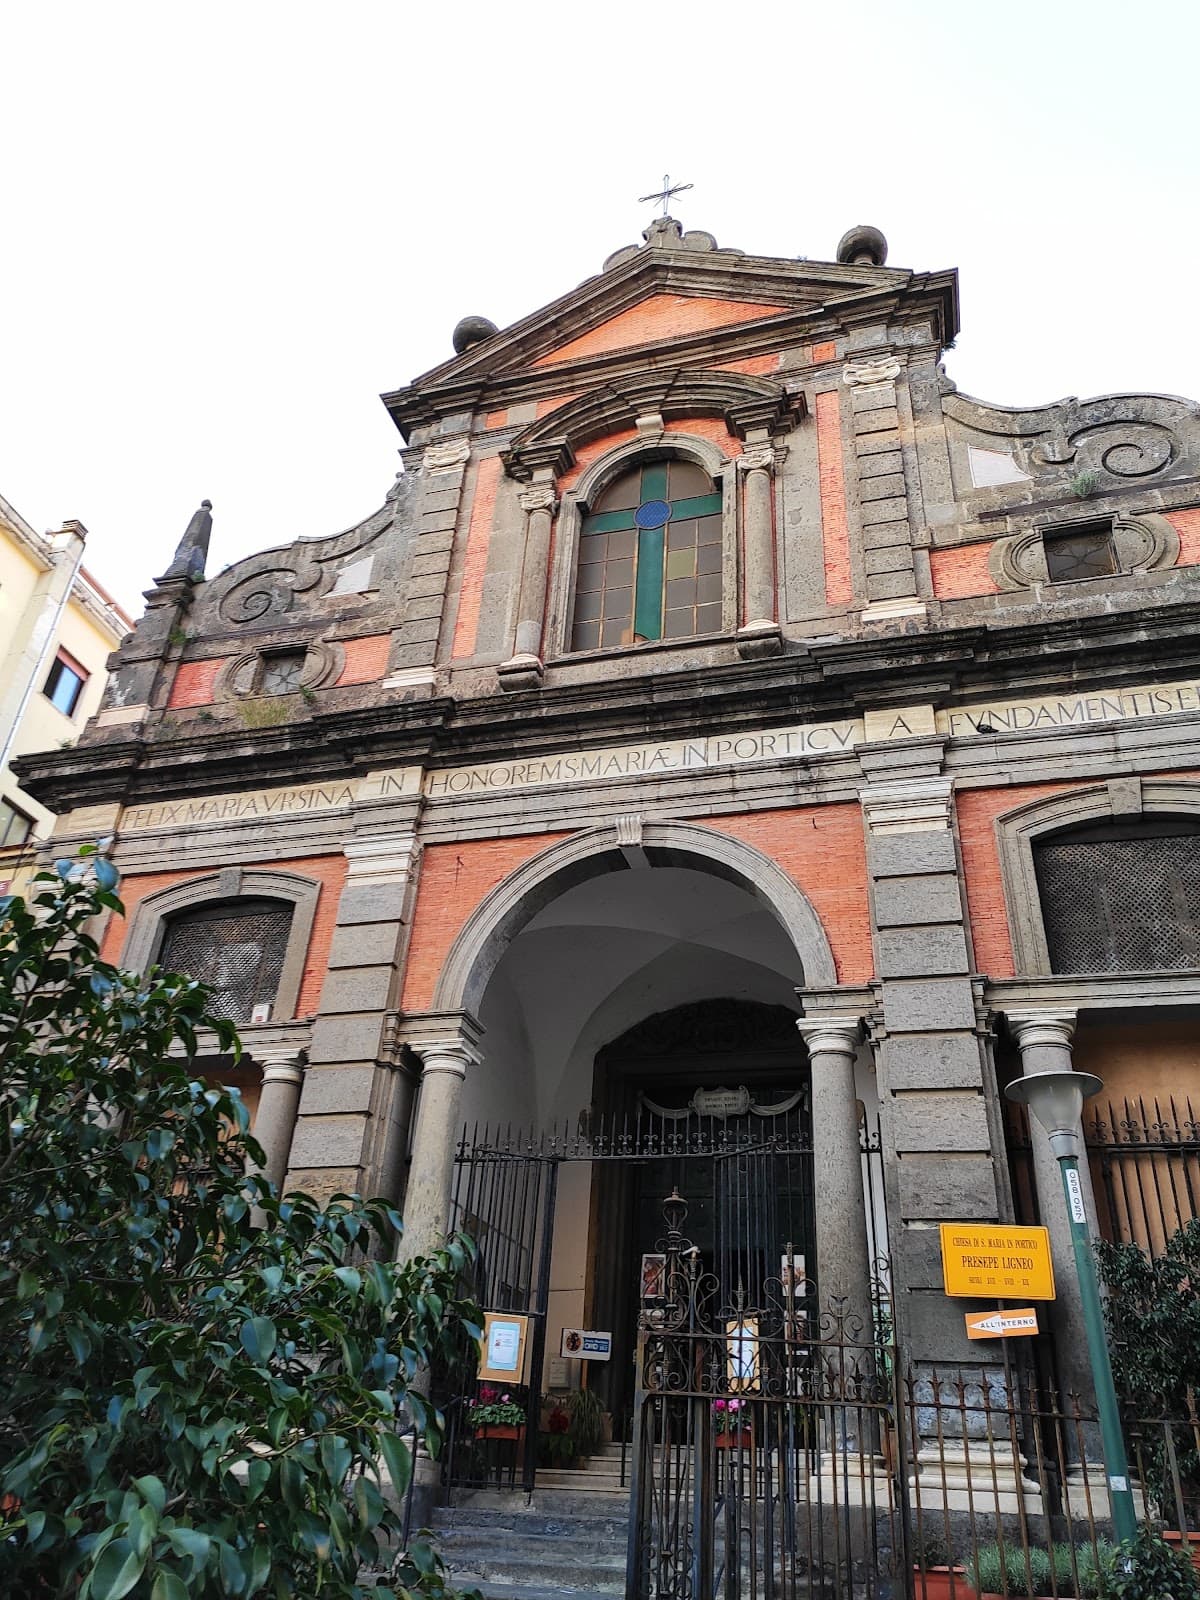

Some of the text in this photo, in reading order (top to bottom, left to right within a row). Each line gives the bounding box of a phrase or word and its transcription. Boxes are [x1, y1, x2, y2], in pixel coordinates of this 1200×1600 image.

[122, 804, 183, 830] FELIX
[184, 798, 258, 823] MARIA
[262, 786, 354, 812] VRSINA
[379, 773, 405, 795] IN
[429, 759, 561, 795] HONOREM
[682, 743, 708, 766] IN
[716, 725, 855, 762] PORTICV
[889, 714, 913, 737] A
[1069, 1171, 1079, 1193] 058
[988, 1238, 1005, 1248] MARIA
[1007, 1239, 1013, 1248] IN
[1015, 1239, 1038, 1249] PORTICO
[961, 1255, 1034, 1270] PRESEPE LIGNEO
[980, 1318, 1034, 1329] ALL'INTERNO
